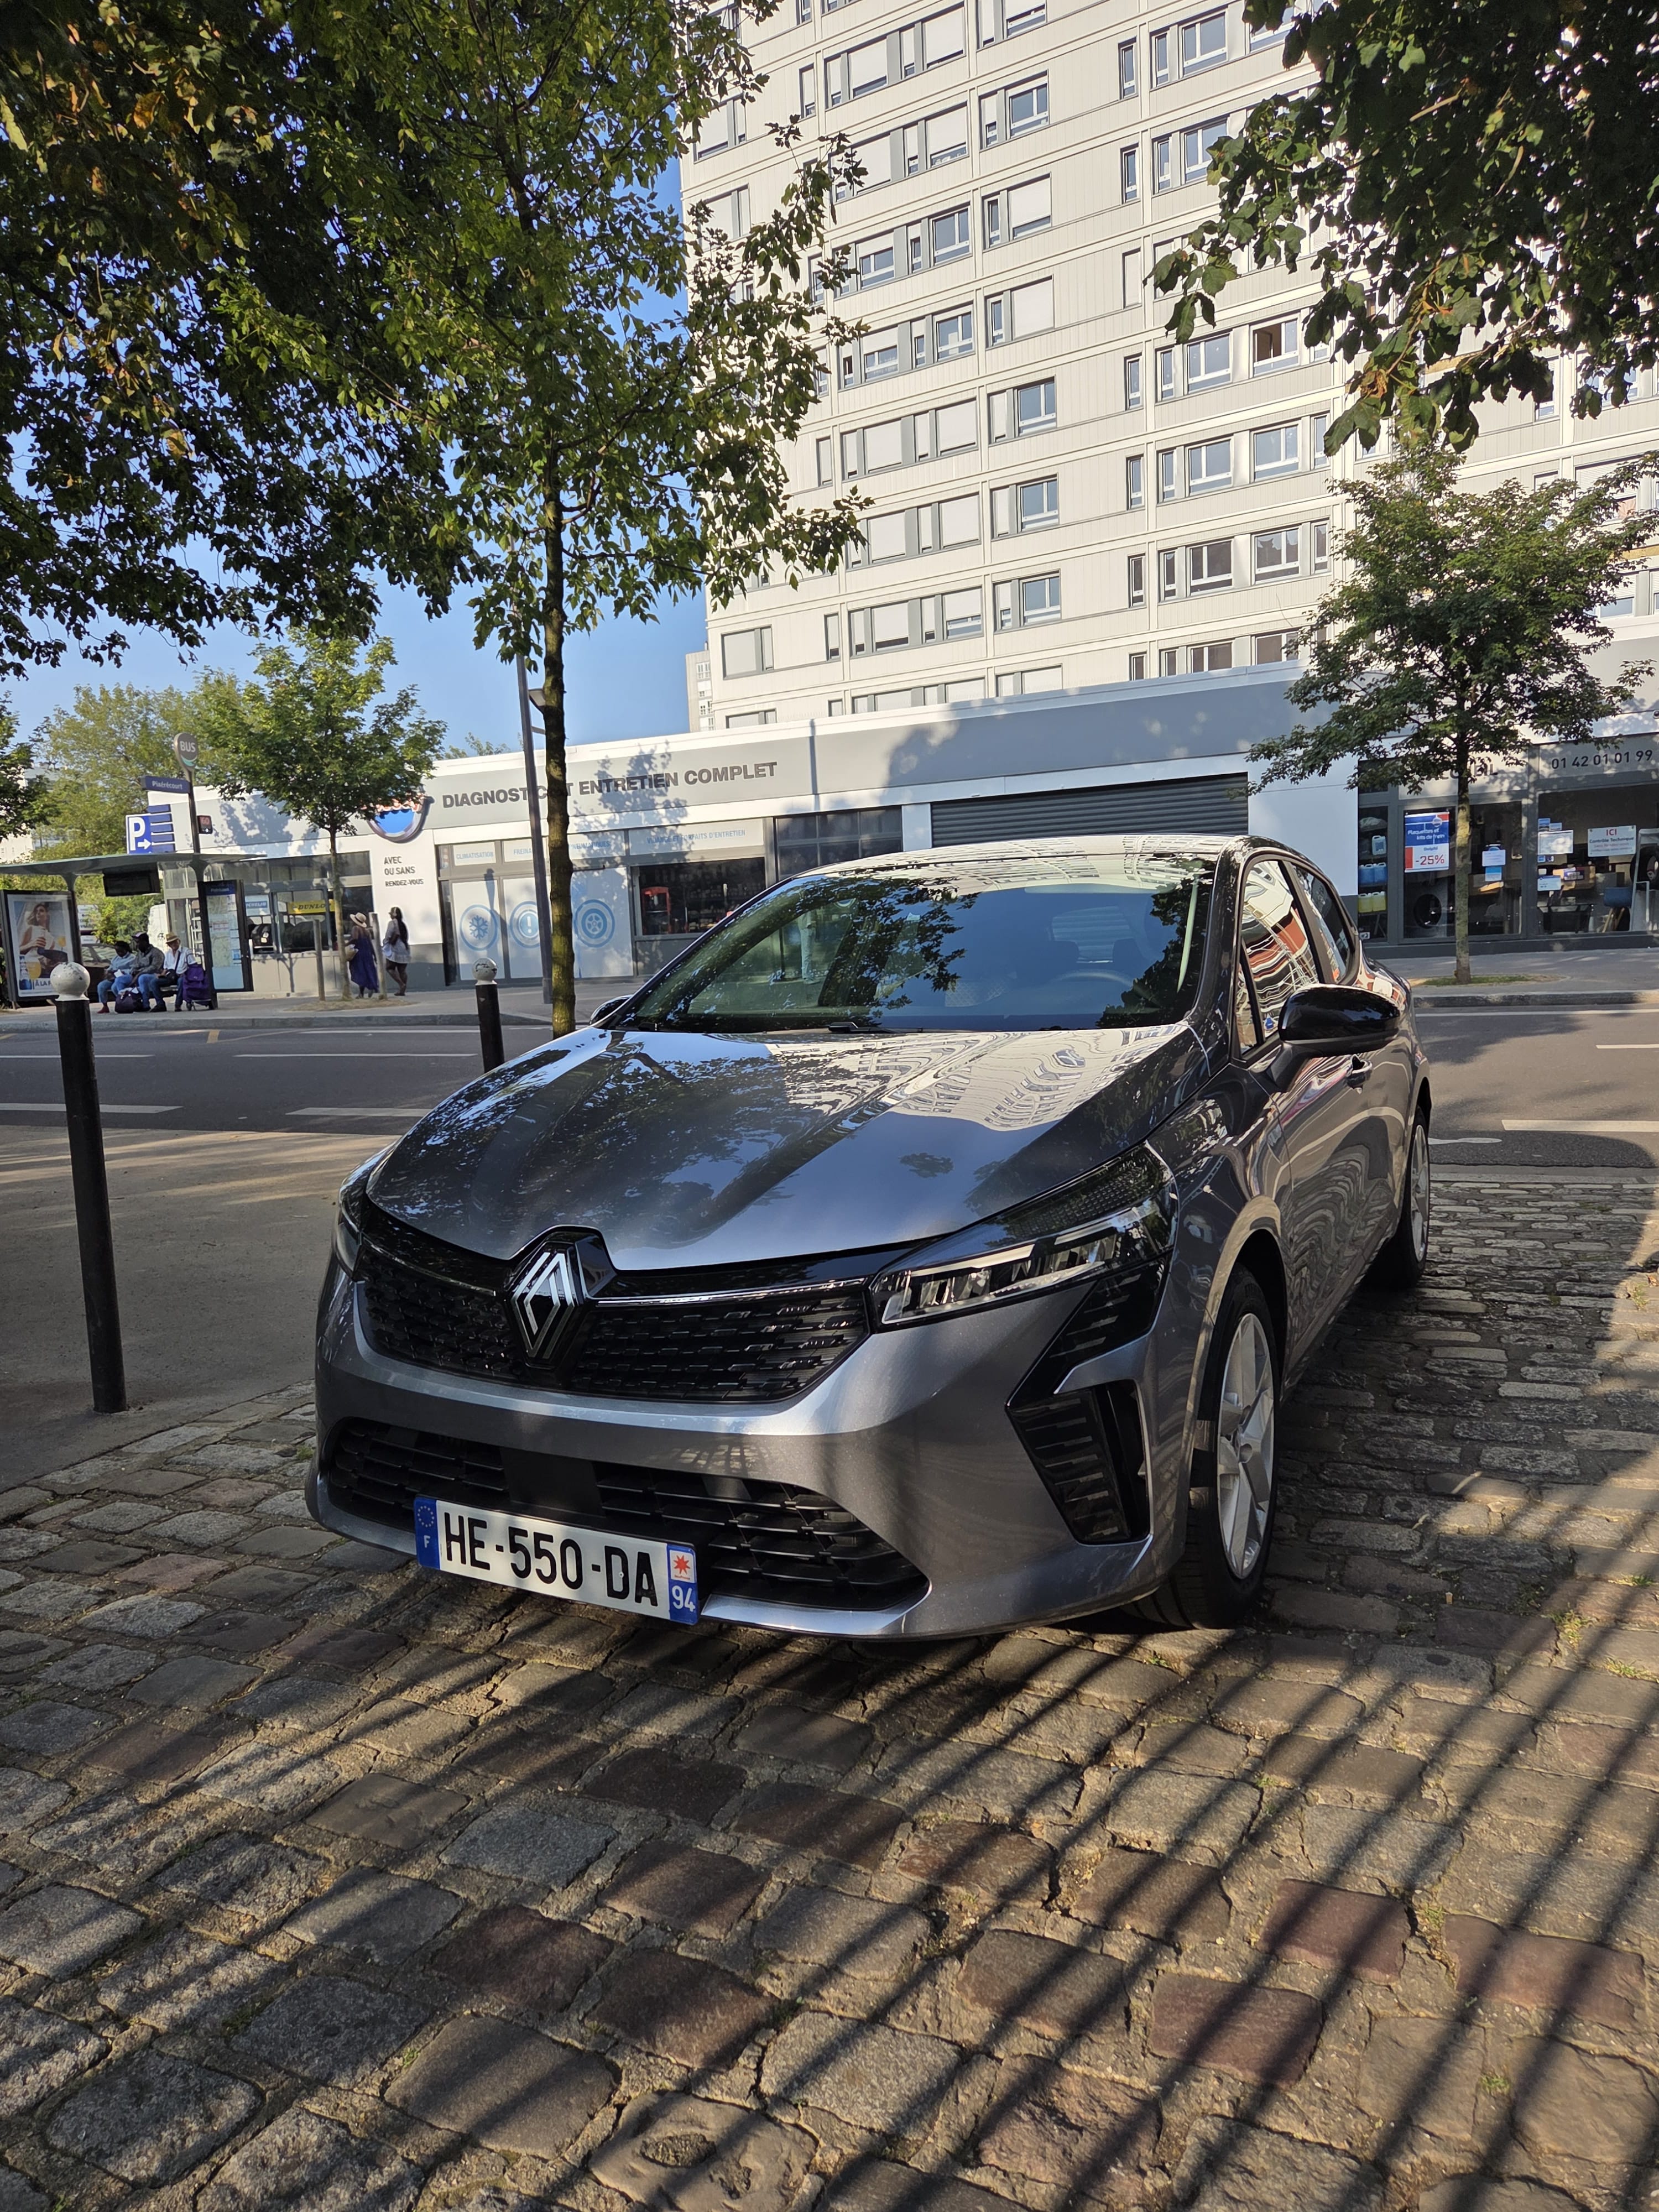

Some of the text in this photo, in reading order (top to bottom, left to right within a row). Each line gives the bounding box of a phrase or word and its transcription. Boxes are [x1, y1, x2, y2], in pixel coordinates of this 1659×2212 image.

[180, 740, 196, 753] BUS
[1552, 750, 1652, 769] 01 42 01 01 99
[442, 785, 547, 808] DIAGNOSTC
[579, 772, 679, 795] ENTRETIEN
[684, 761, 778, 785] COMPLET
[128, 817, 145, 851] P
[681, 832, 707, 842] FORFAITS
[709, 830, 745, 839] D'ENTRETIEN
[384, 856, 402, 864] AVEC
[456, 851, 494, 860] CLIMATISATION
[1415, 854, 1444, 865] -25%
[396, 866, 415, 874] SANS
[385, 878, 424, 887] RENDEZ-VOUS
[423, 1535, 430, 1548] F
[444, 1512, 659, 1607] HE-550-DA
[671, 1585, 696, 1612] 94
